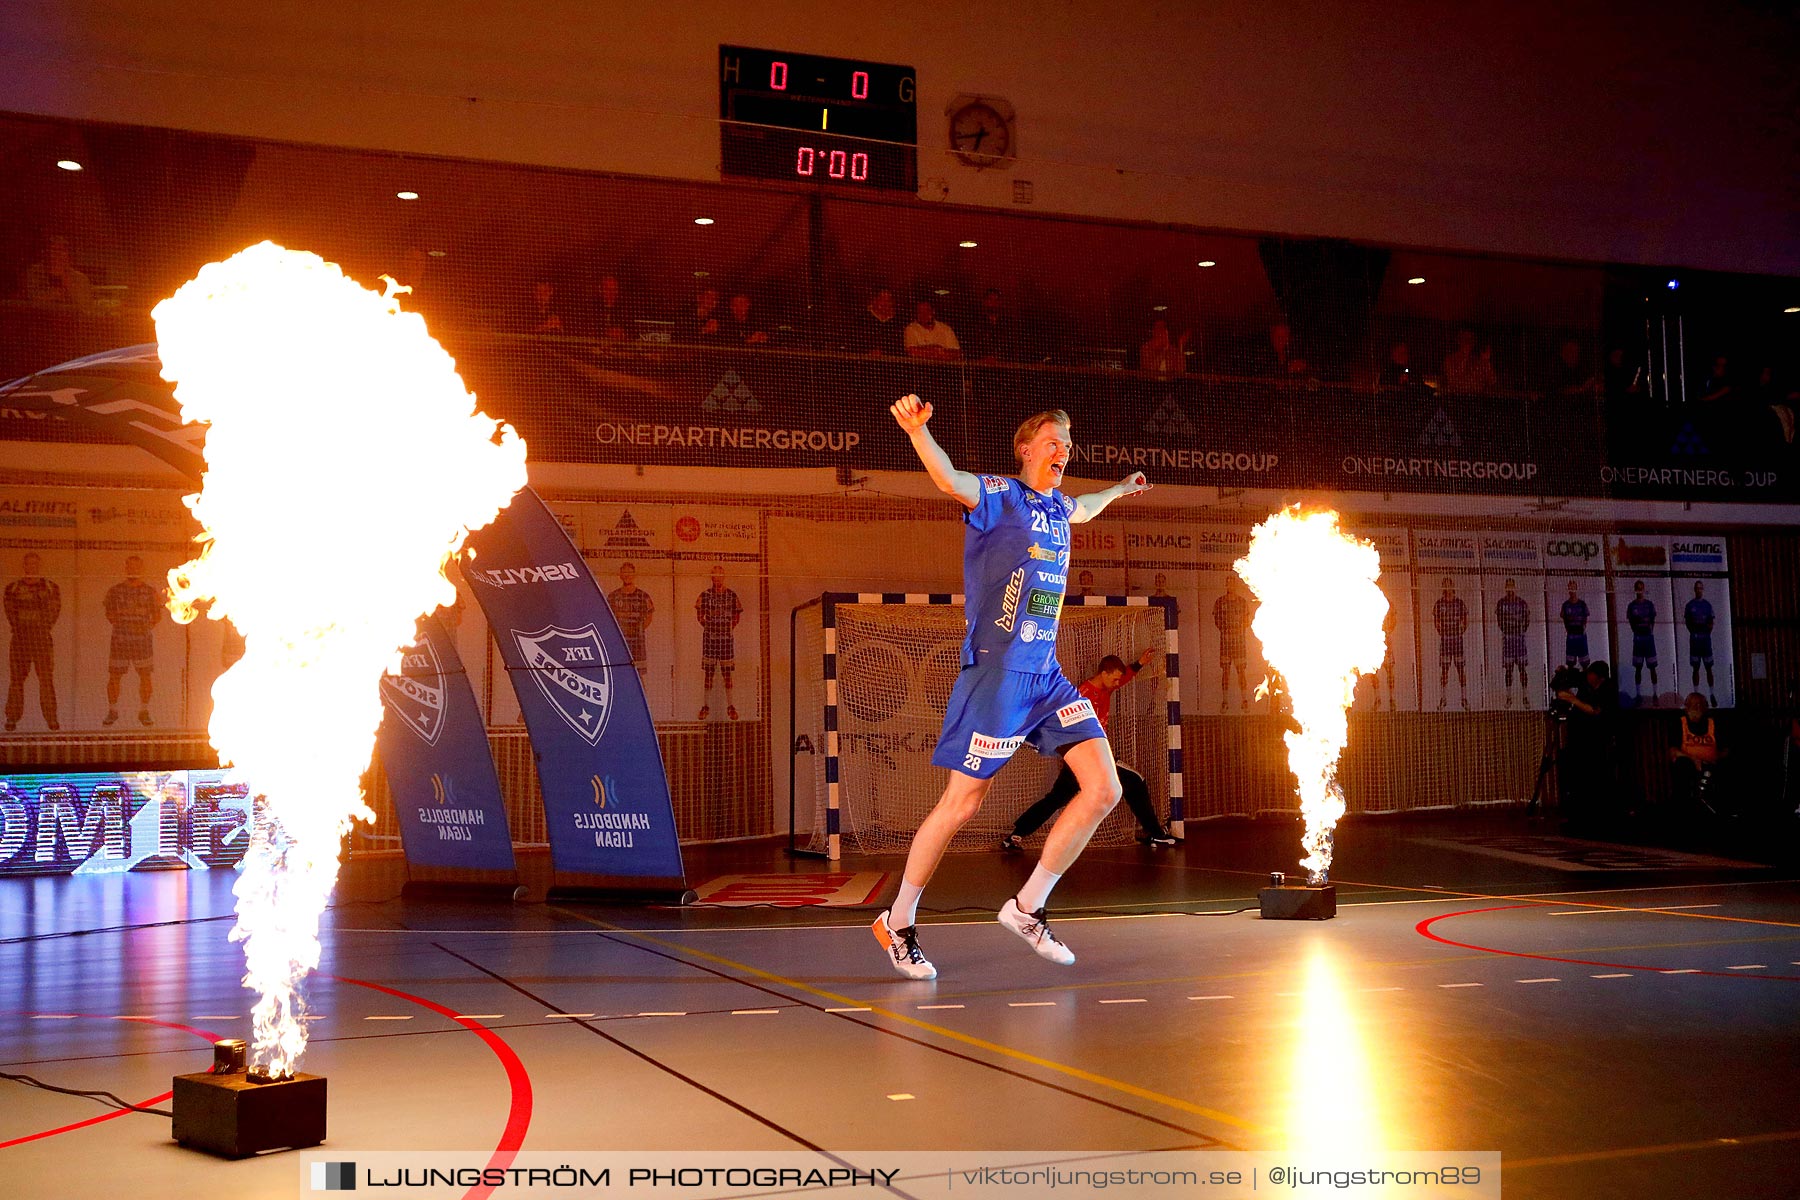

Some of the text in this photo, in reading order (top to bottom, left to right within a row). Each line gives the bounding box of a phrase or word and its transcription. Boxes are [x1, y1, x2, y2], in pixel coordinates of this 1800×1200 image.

[723, 55, 741, 85] H
[770, 61, 788, 91] 0
[851, 71, 869, 100] 0
[898, 76, 915, 103] G
[596, 422, 860, 451] ONEPARTNERGROUP
[1342, 456, 1538, 480] ONEPARTNERGROUP
[1600, 464, 1777, 487] ONEPARTNERGOUP
[1031, 509, 1050, 534] 28
[1546, 540, 1600, 561] coop
[963, 753, 982, 771] 28
